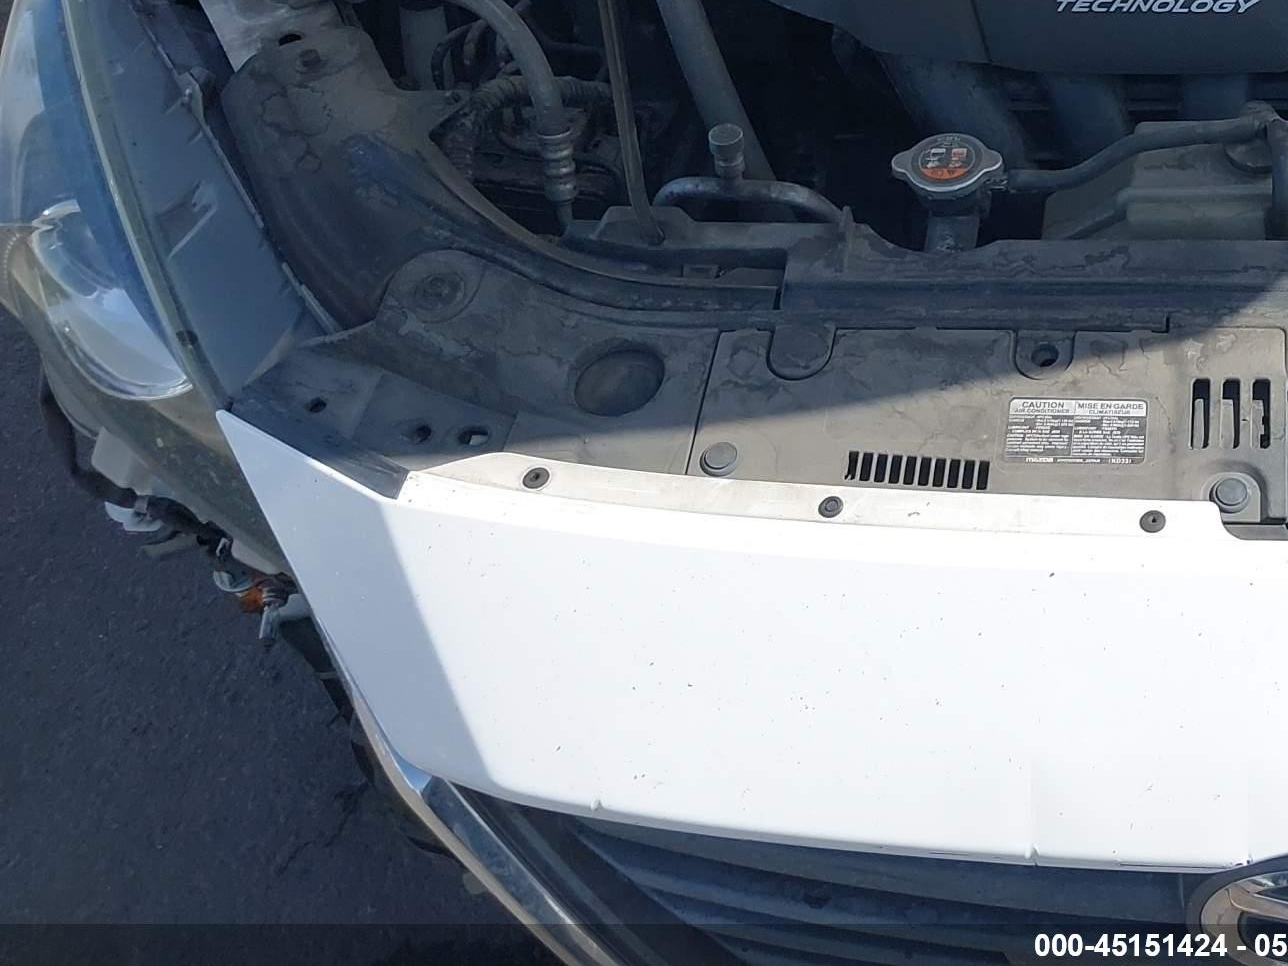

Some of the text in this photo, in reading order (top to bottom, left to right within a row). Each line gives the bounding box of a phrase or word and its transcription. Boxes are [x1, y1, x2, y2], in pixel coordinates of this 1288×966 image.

[1021, 401, 1065, 409] CAUTION
[1077, 402, 1098, 410] MISE
[1100, 402, 1112, 410] EN
